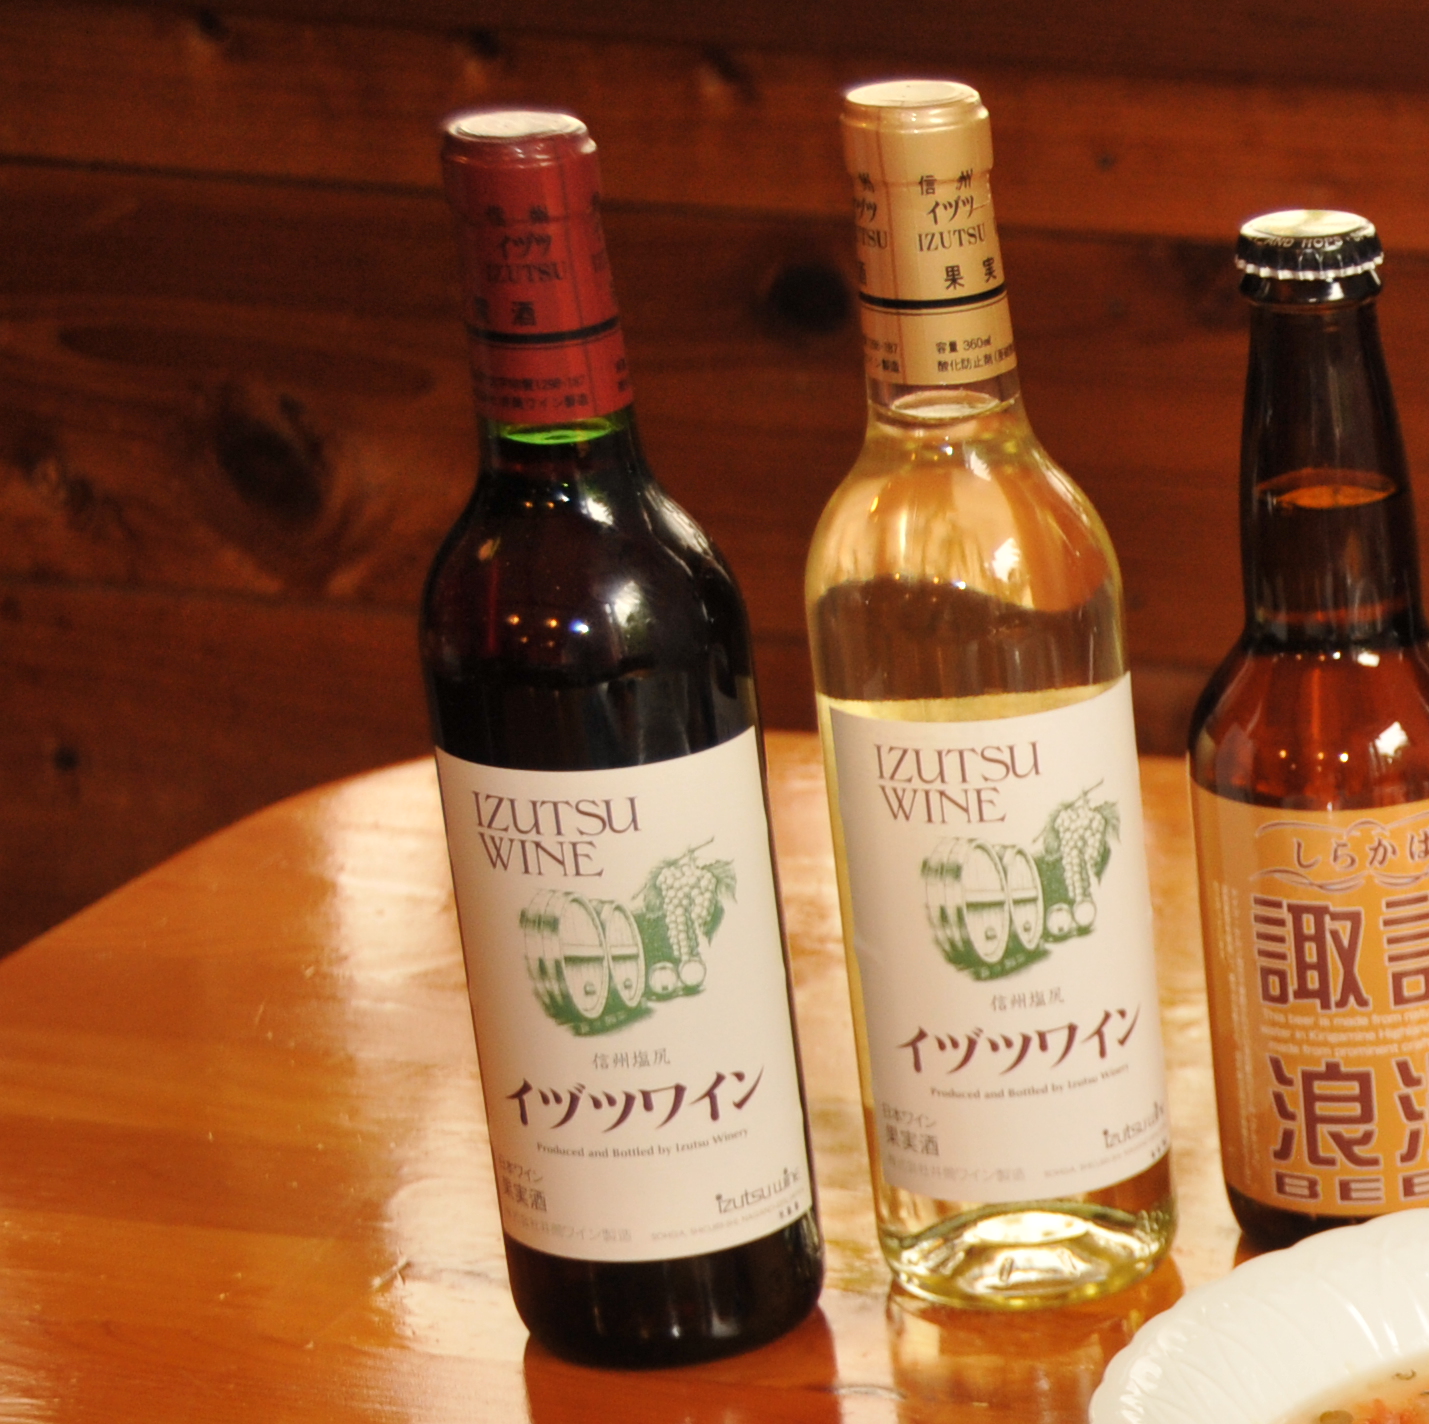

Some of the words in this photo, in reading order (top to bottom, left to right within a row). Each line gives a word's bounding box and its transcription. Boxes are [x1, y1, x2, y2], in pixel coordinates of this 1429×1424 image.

[927, 195, 974, 225] イヅツ
[918, 223, 986, 252] IZUTSU
[875, 739, 1041, 784] IZUTSU
[472, 790, 642, 836] IZUTSU
[879, 783, 1006, 825] WINE
[478, 831, 604, 877] WINE
[990, 987, 1065, 1011] 信州塩尻
[592, 1048, 671, 1069] 信州塩尻
[897, 1003, 1142, 1076] イヅツワイン
[506, 1064, 765, 1133] イヅツワイン
[536, 1142, 584, 1158] Produced
[588, 1147, 609, 1158] and
[612, 1145, 654, 1158] Bottled
[657, 1144, 672, 1157] by
[676, 1138, 710, 1153] Izutsu
